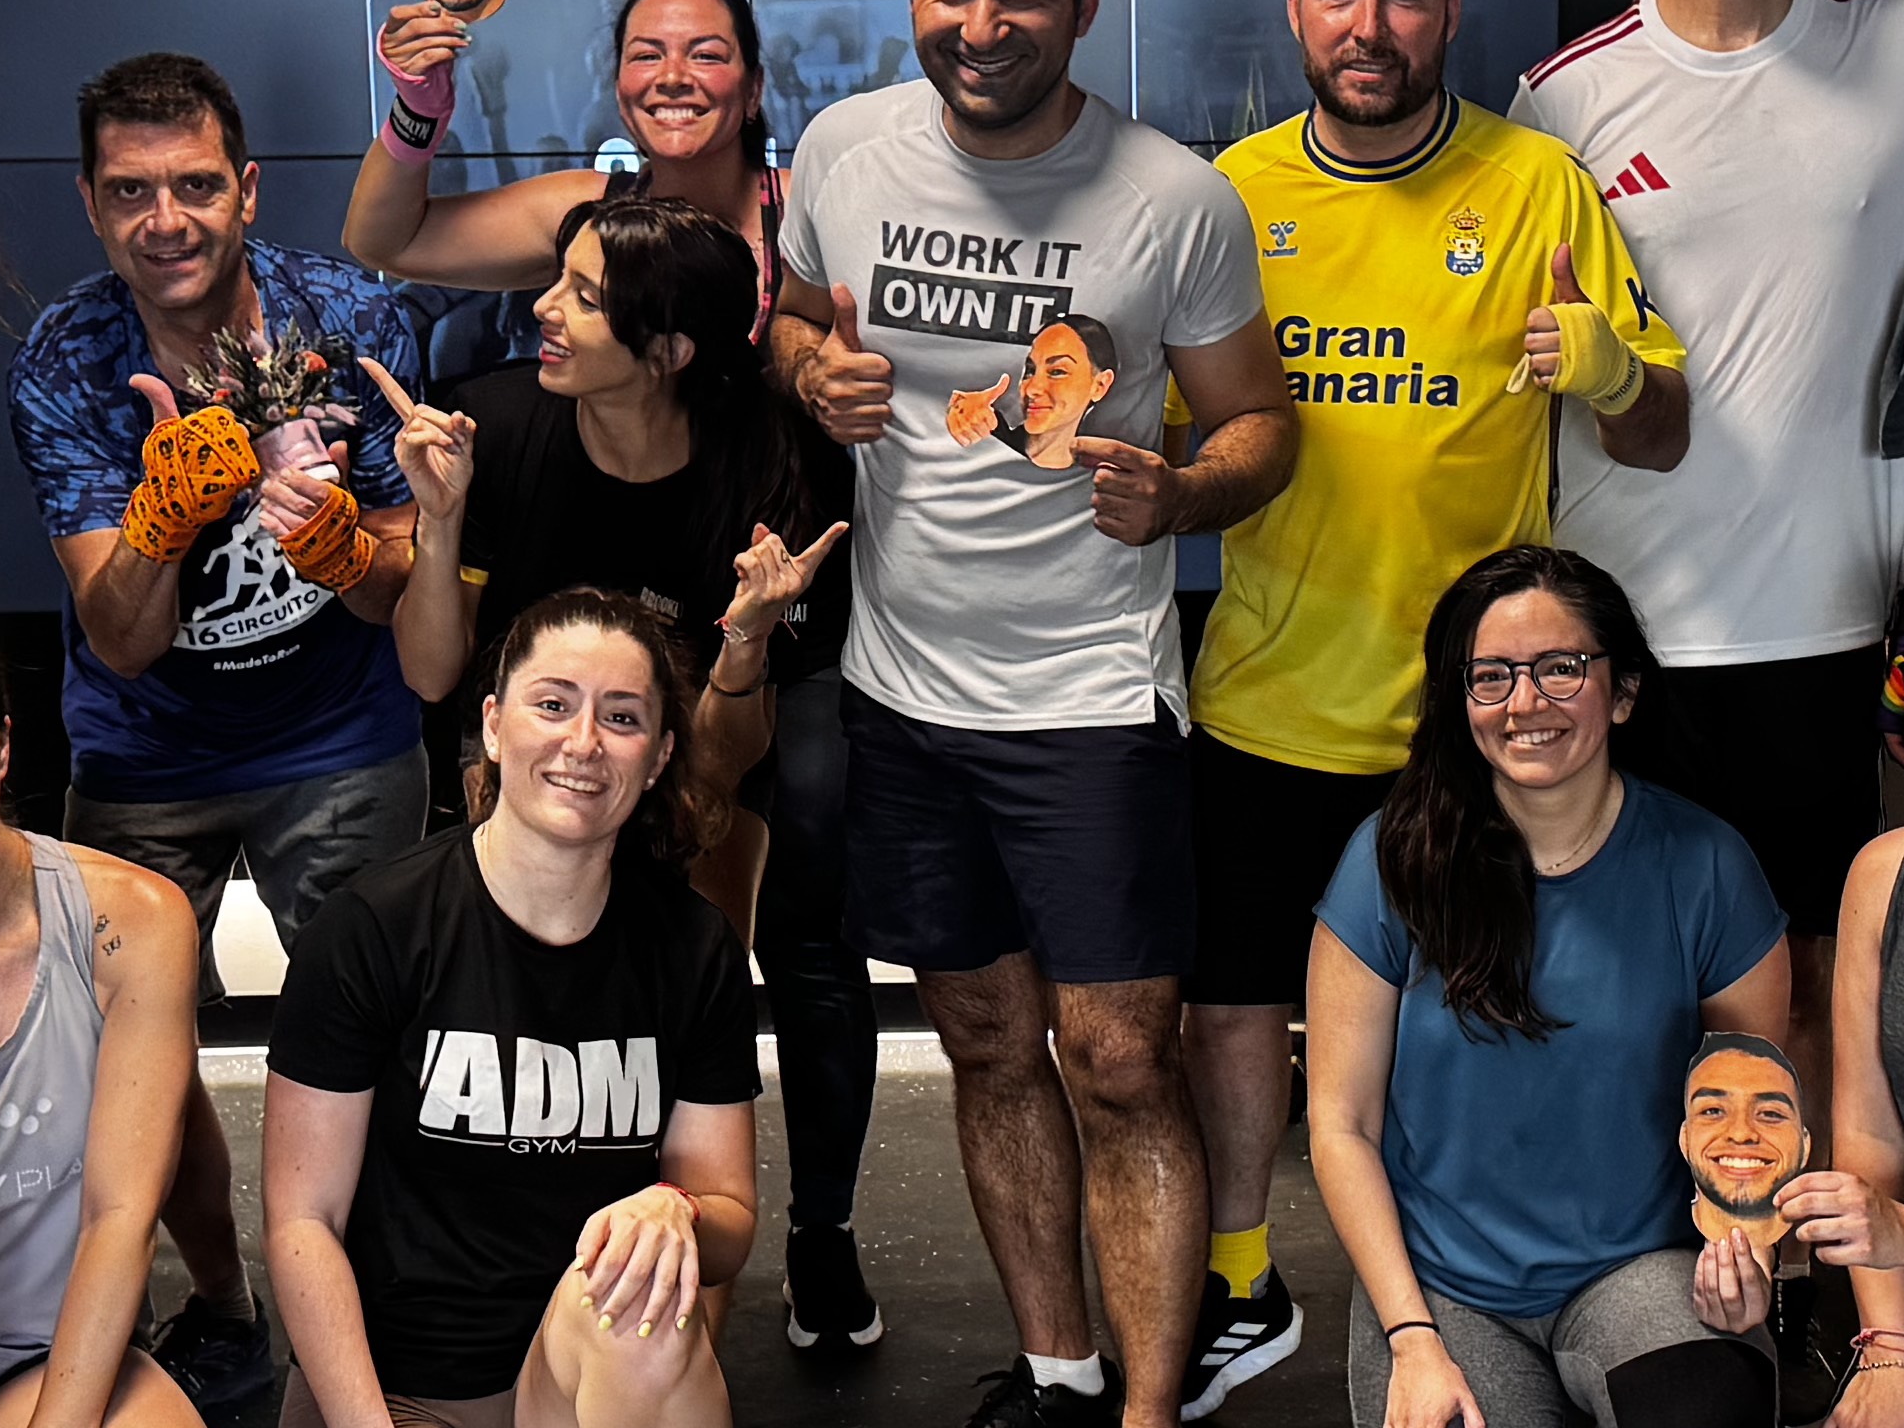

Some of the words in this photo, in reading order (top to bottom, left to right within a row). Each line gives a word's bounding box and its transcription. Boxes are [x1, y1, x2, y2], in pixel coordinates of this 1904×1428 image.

[882, 220, 1024, 277] WORK
[1034, 241, 1082, 280] IT
[883, 279, 996, 330] OWN
[1007, 294, 1056, 336] IT
[1274, 315, 1406, 359] Gran
[1287, 362, 1460, 407] anaria
[182, 625, 221, 646] 16
[221, 589, 319, 636] CIRCUITO
[418, 1029, 660, 1138] ADM
[507, 1138, 576, 1154] GYM
